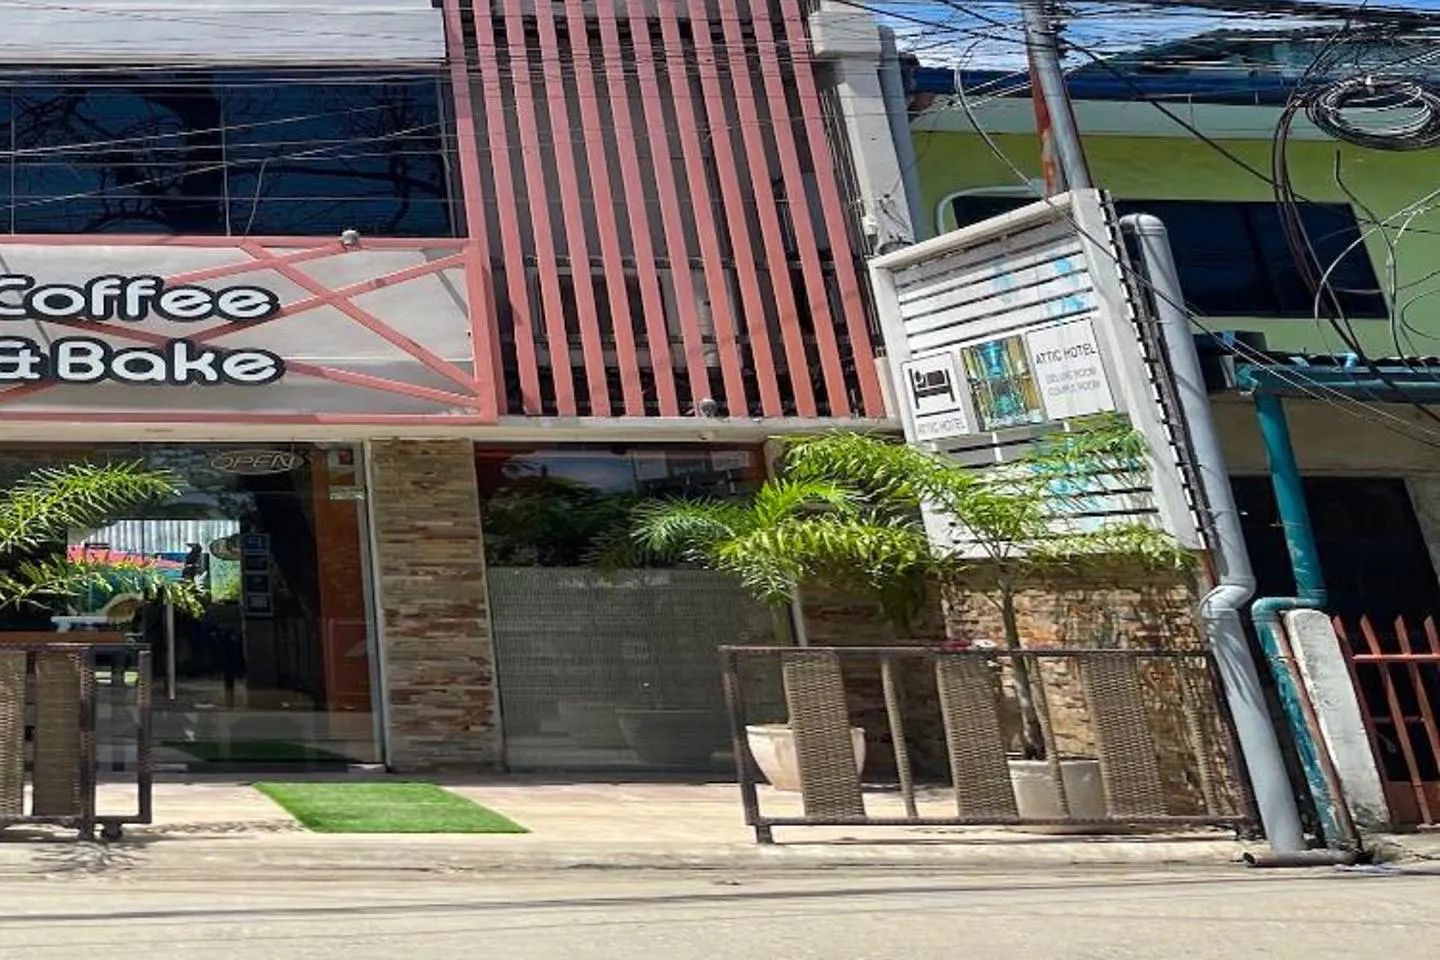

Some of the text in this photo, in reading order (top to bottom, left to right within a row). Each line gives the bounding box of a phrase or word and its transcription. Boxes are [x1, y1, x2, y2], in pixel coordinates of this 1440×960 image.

[52, 338, 281, 383] Bake
[1035, 342, 1097, 364] ATTIC HOTEL
[213, 455, 295, 469] OPEN
